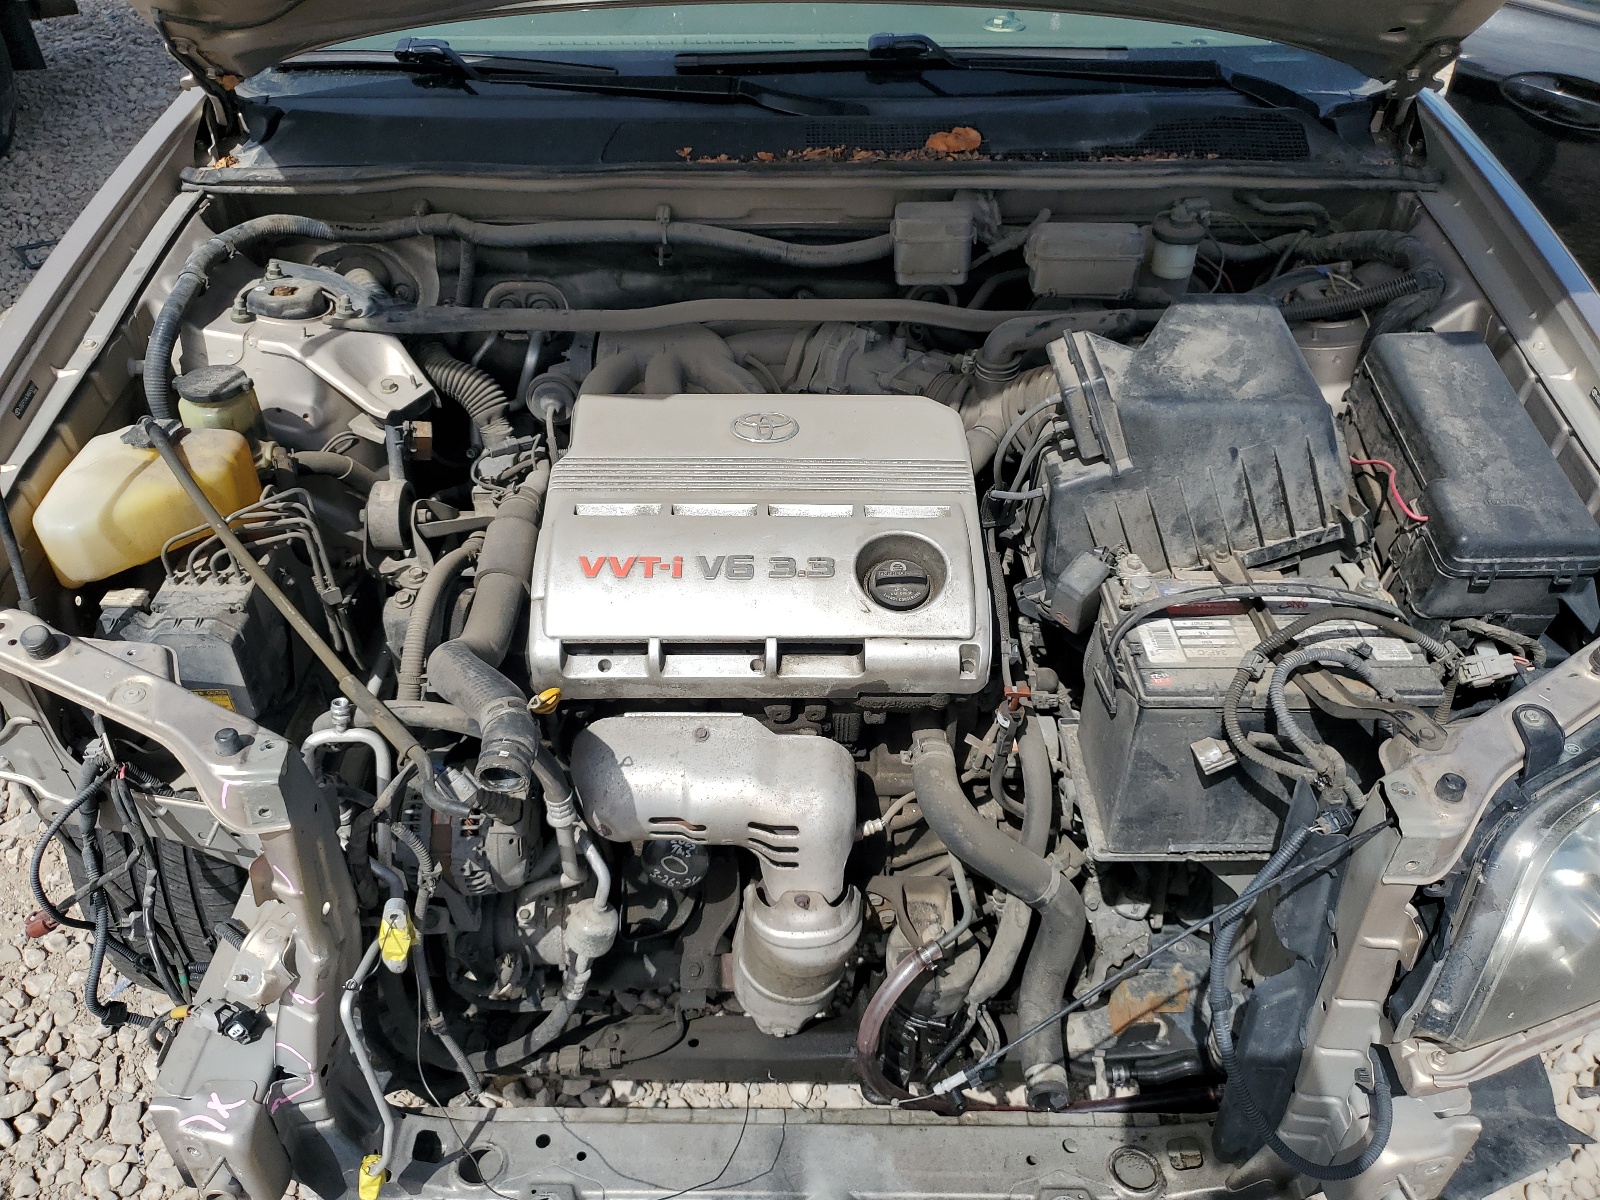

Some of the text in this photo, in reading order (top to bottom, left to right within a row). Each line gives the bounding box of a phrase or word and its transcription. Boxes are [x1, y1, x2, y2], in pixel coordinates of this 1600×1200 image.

[579, 554, 836, 580] VVT-i V6 3.3
[649, 868, 701, 888] 3-26-24
